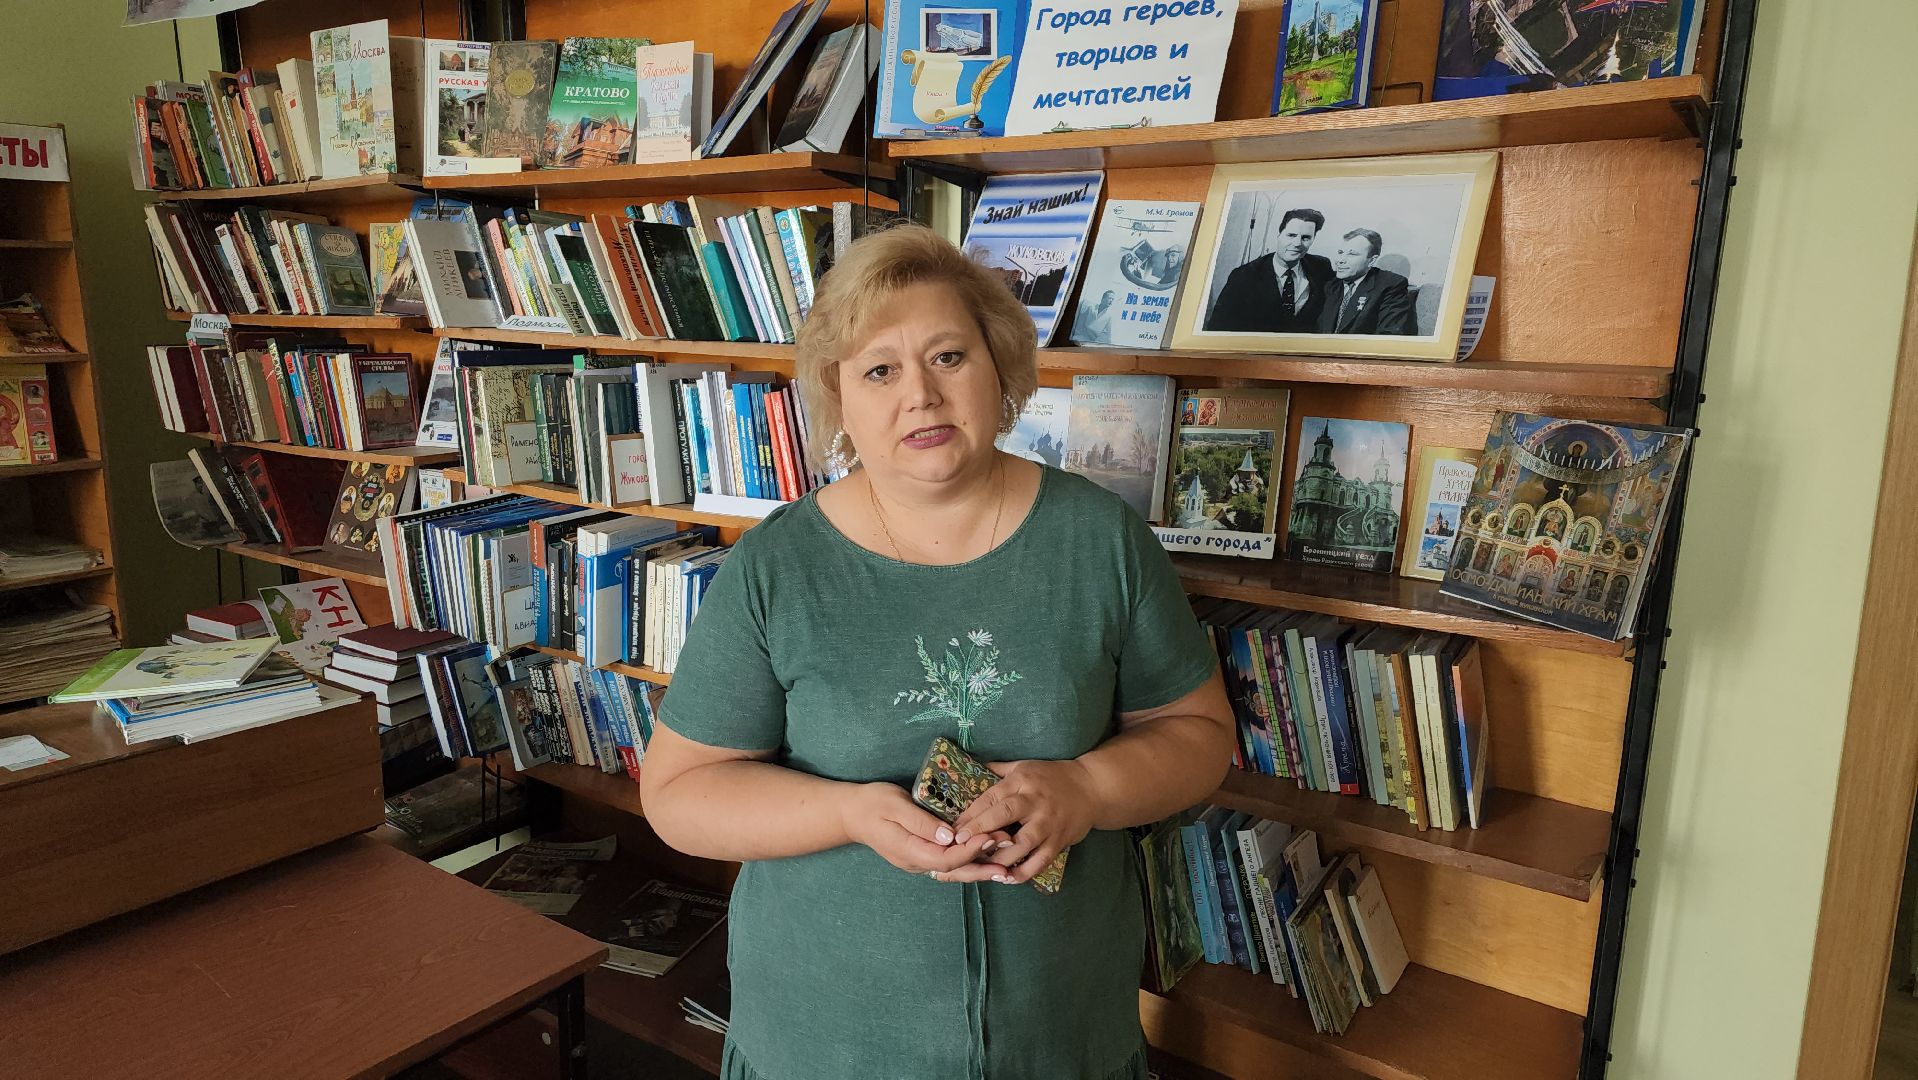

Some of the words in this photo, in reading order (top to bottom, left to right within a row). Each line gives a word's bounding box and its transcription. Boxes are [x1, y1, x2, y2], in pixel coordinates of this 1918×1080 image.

[1036, 6, 1111, 33] Город
[1123, 1, 1223, 25] героев,
[1055, 42, 1157, 70] творцов
[1169, 42, 1189, 60] и
[439, 78, 479, 87] РУССКАЯ
[564, 86, 630, 99] КРАТОВО
[1033, 75, 1192, 110] мечтателей
[983, 199, 1025, 224] Знай
[1027, 183, 1090, 215] наших!
[1167, 208, 1194, 217] Громов
[1125, 292, 1138, 306] На
[1141, 295, 1170, 308] земле
[1140, 309, 1162, 324] небе
[309, 367, 325, 409] МОСКВА
[677, 420, 690, 466] ПРОГУЛКИ
[1156, 533, 1202, 546] шего
[1577, 604, 1618, 625] ХРАМ
